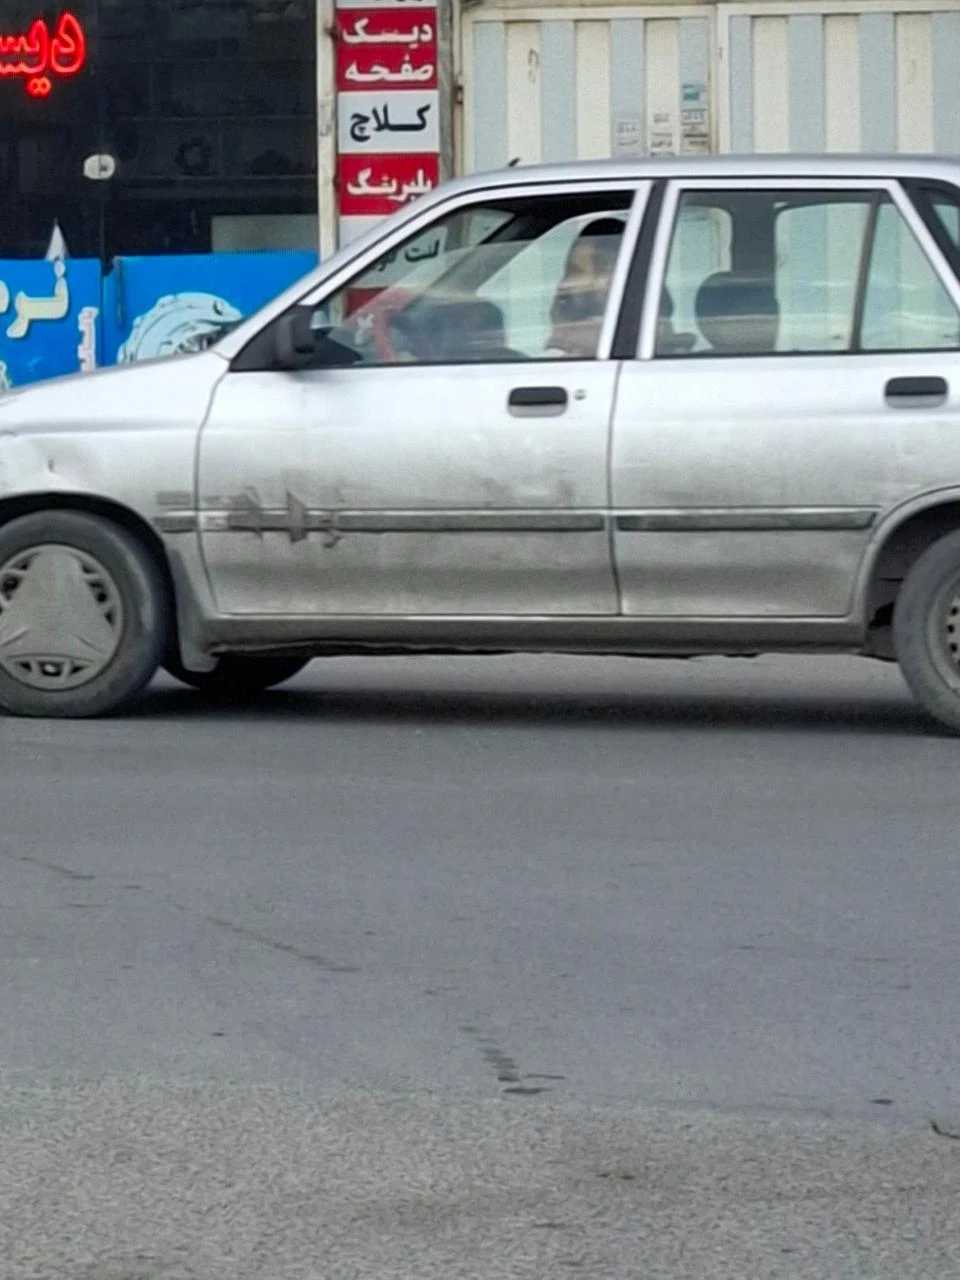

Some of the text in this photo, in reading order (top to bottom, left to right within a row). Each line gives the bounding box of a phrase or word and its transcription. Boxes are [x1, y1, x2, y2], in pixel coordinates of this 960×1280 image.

[342, 17, 433, 49] دیسک
[345, 53, 434, 82] صفحه
[350, 103, 431, 142] کلاچ
